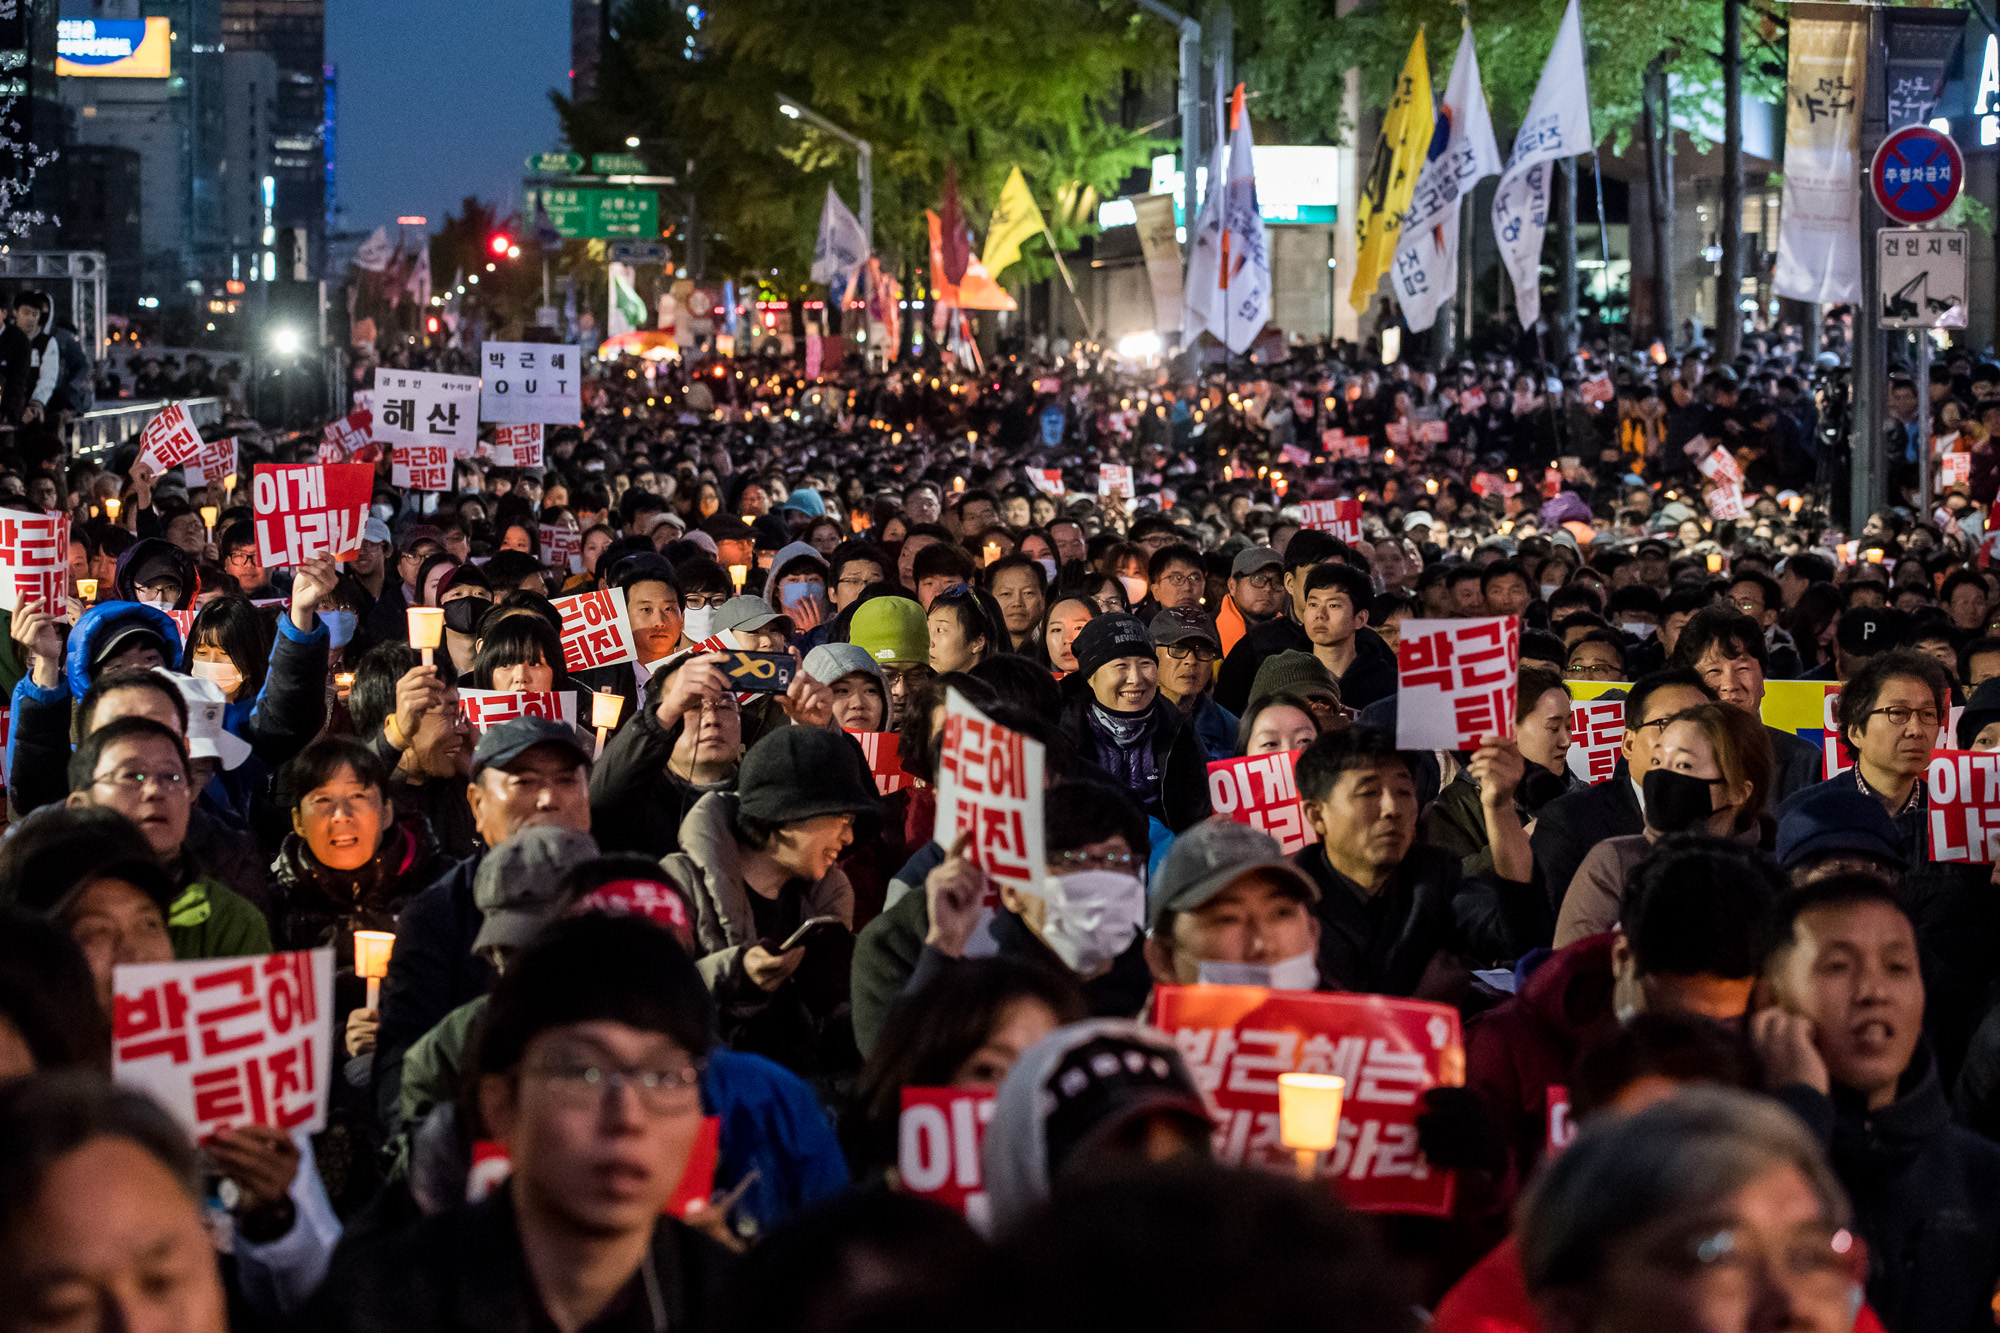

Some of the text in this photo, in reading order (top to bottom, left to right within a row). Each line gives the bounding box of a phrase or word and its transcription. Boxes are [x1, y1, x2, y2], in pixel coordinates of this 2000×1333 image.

[1885, 238, 1962, 256] 견인지역
[489, 352, 565, 370] 박근혜
[495, 379, 567, 395] OUT
[383, 399, 460, 435] 해산
[153, 427, 199, 468] 퇴진
[393, 446, 448, 468] 박근혜
[253, 465, 327, 515] 이게
[409, 467, 447, 489] 퇴진
[1300, 501, 1337, 524] 이게
[555, 589, 618, 638] 근혜
[1863, 622, 1876, 640] P
[942, 713, 1027, 801] 박근혜
[1208, 752, 1297, 814] 이게
[114, 950, 317, 1066] 박근혜
[193, 1038, 315, 1147] 퇴진
